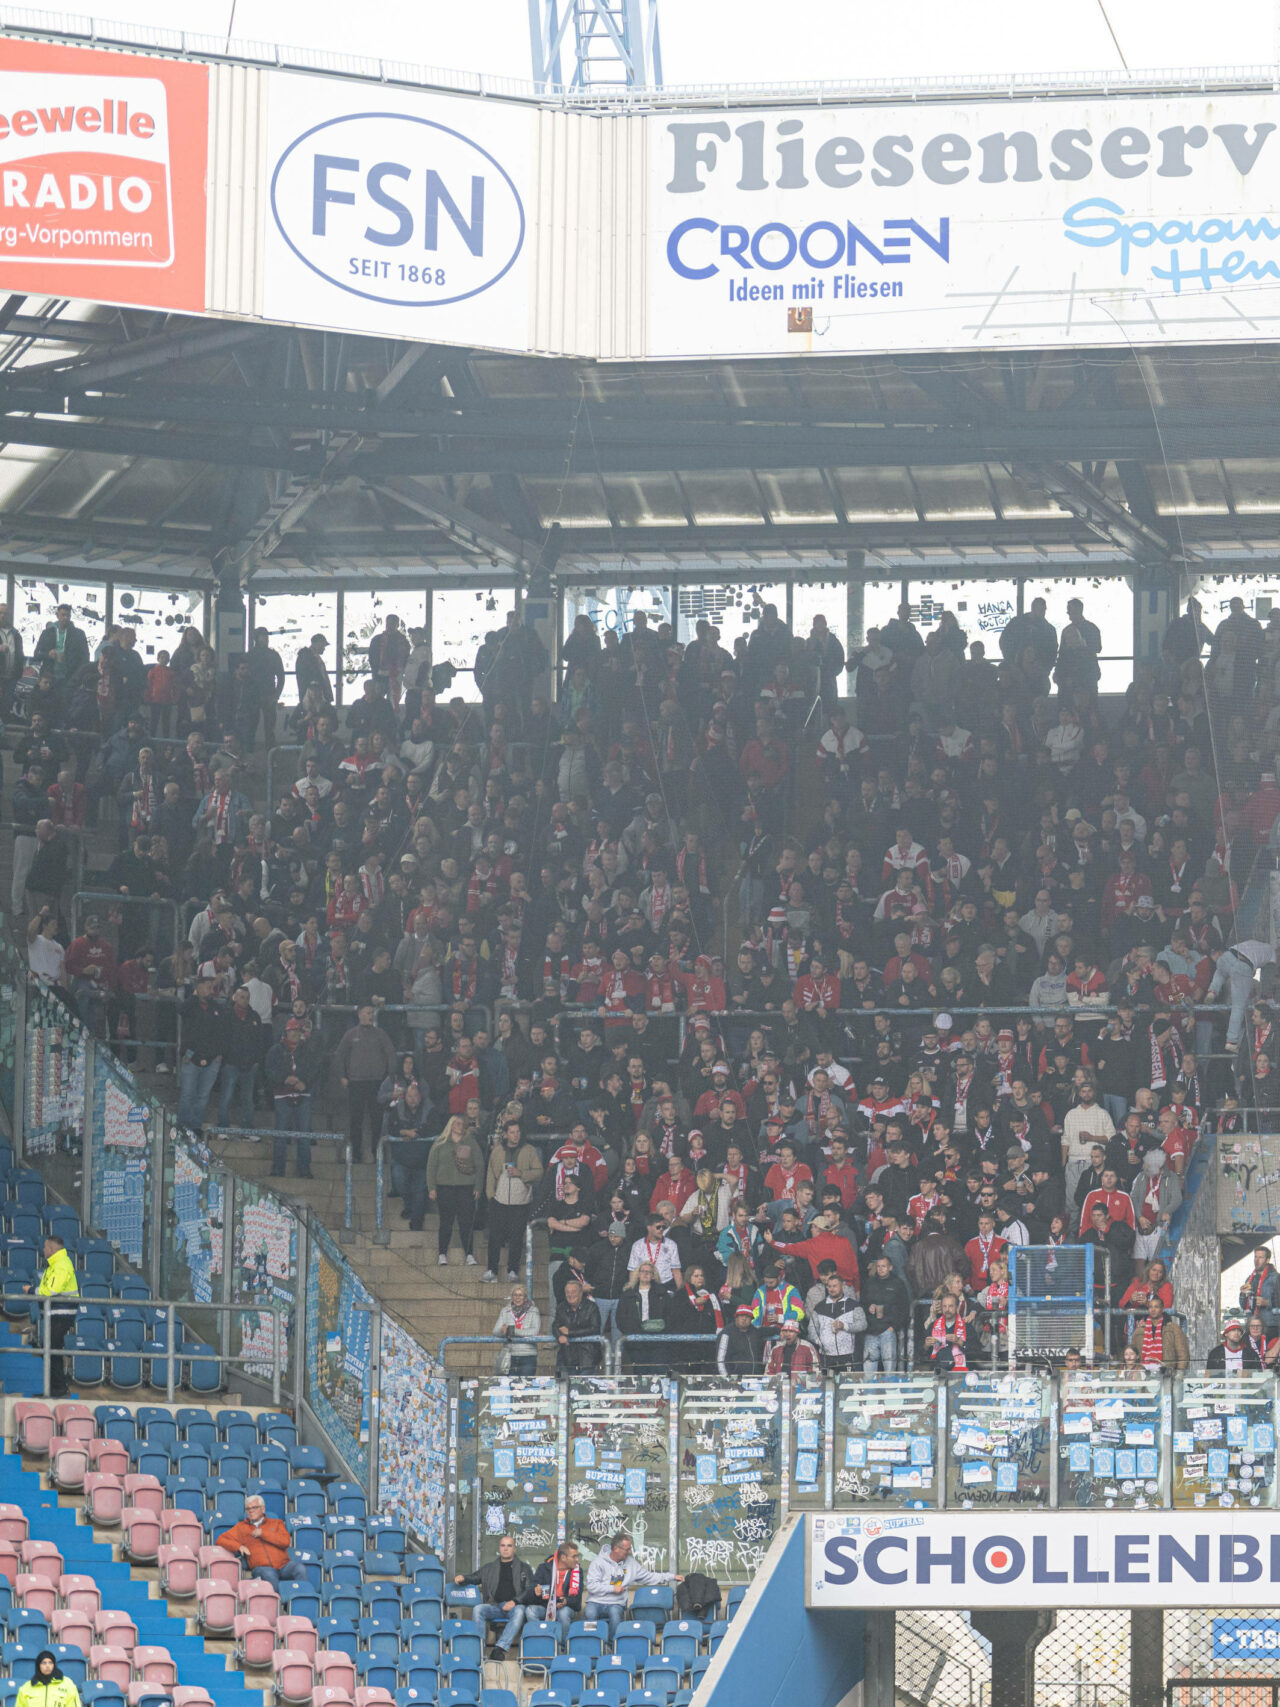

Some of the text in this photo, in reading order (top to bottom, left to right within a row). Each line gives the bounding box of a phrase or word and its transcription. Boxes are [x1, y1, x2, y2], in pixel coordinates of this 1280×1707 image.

[3, 170, 152, 214] RADIO
[312, 154, 485, 257] FSN
[666, 217, 950, 281] CROONEN
[349, 257, 446, 286] SEIT 1868
[729, 274, 904, 303] Ideen mit Fliesen
[978, 600, 1014, 614] HANSA
[516, 1447, 555, 1457] SUPTRAS
[724, 1447, 764, 1458] SUPTRAS
[585, 1470, 624, 1484] SUPTRAS
[722, 1471, 761, 1486] SUPTRAS
